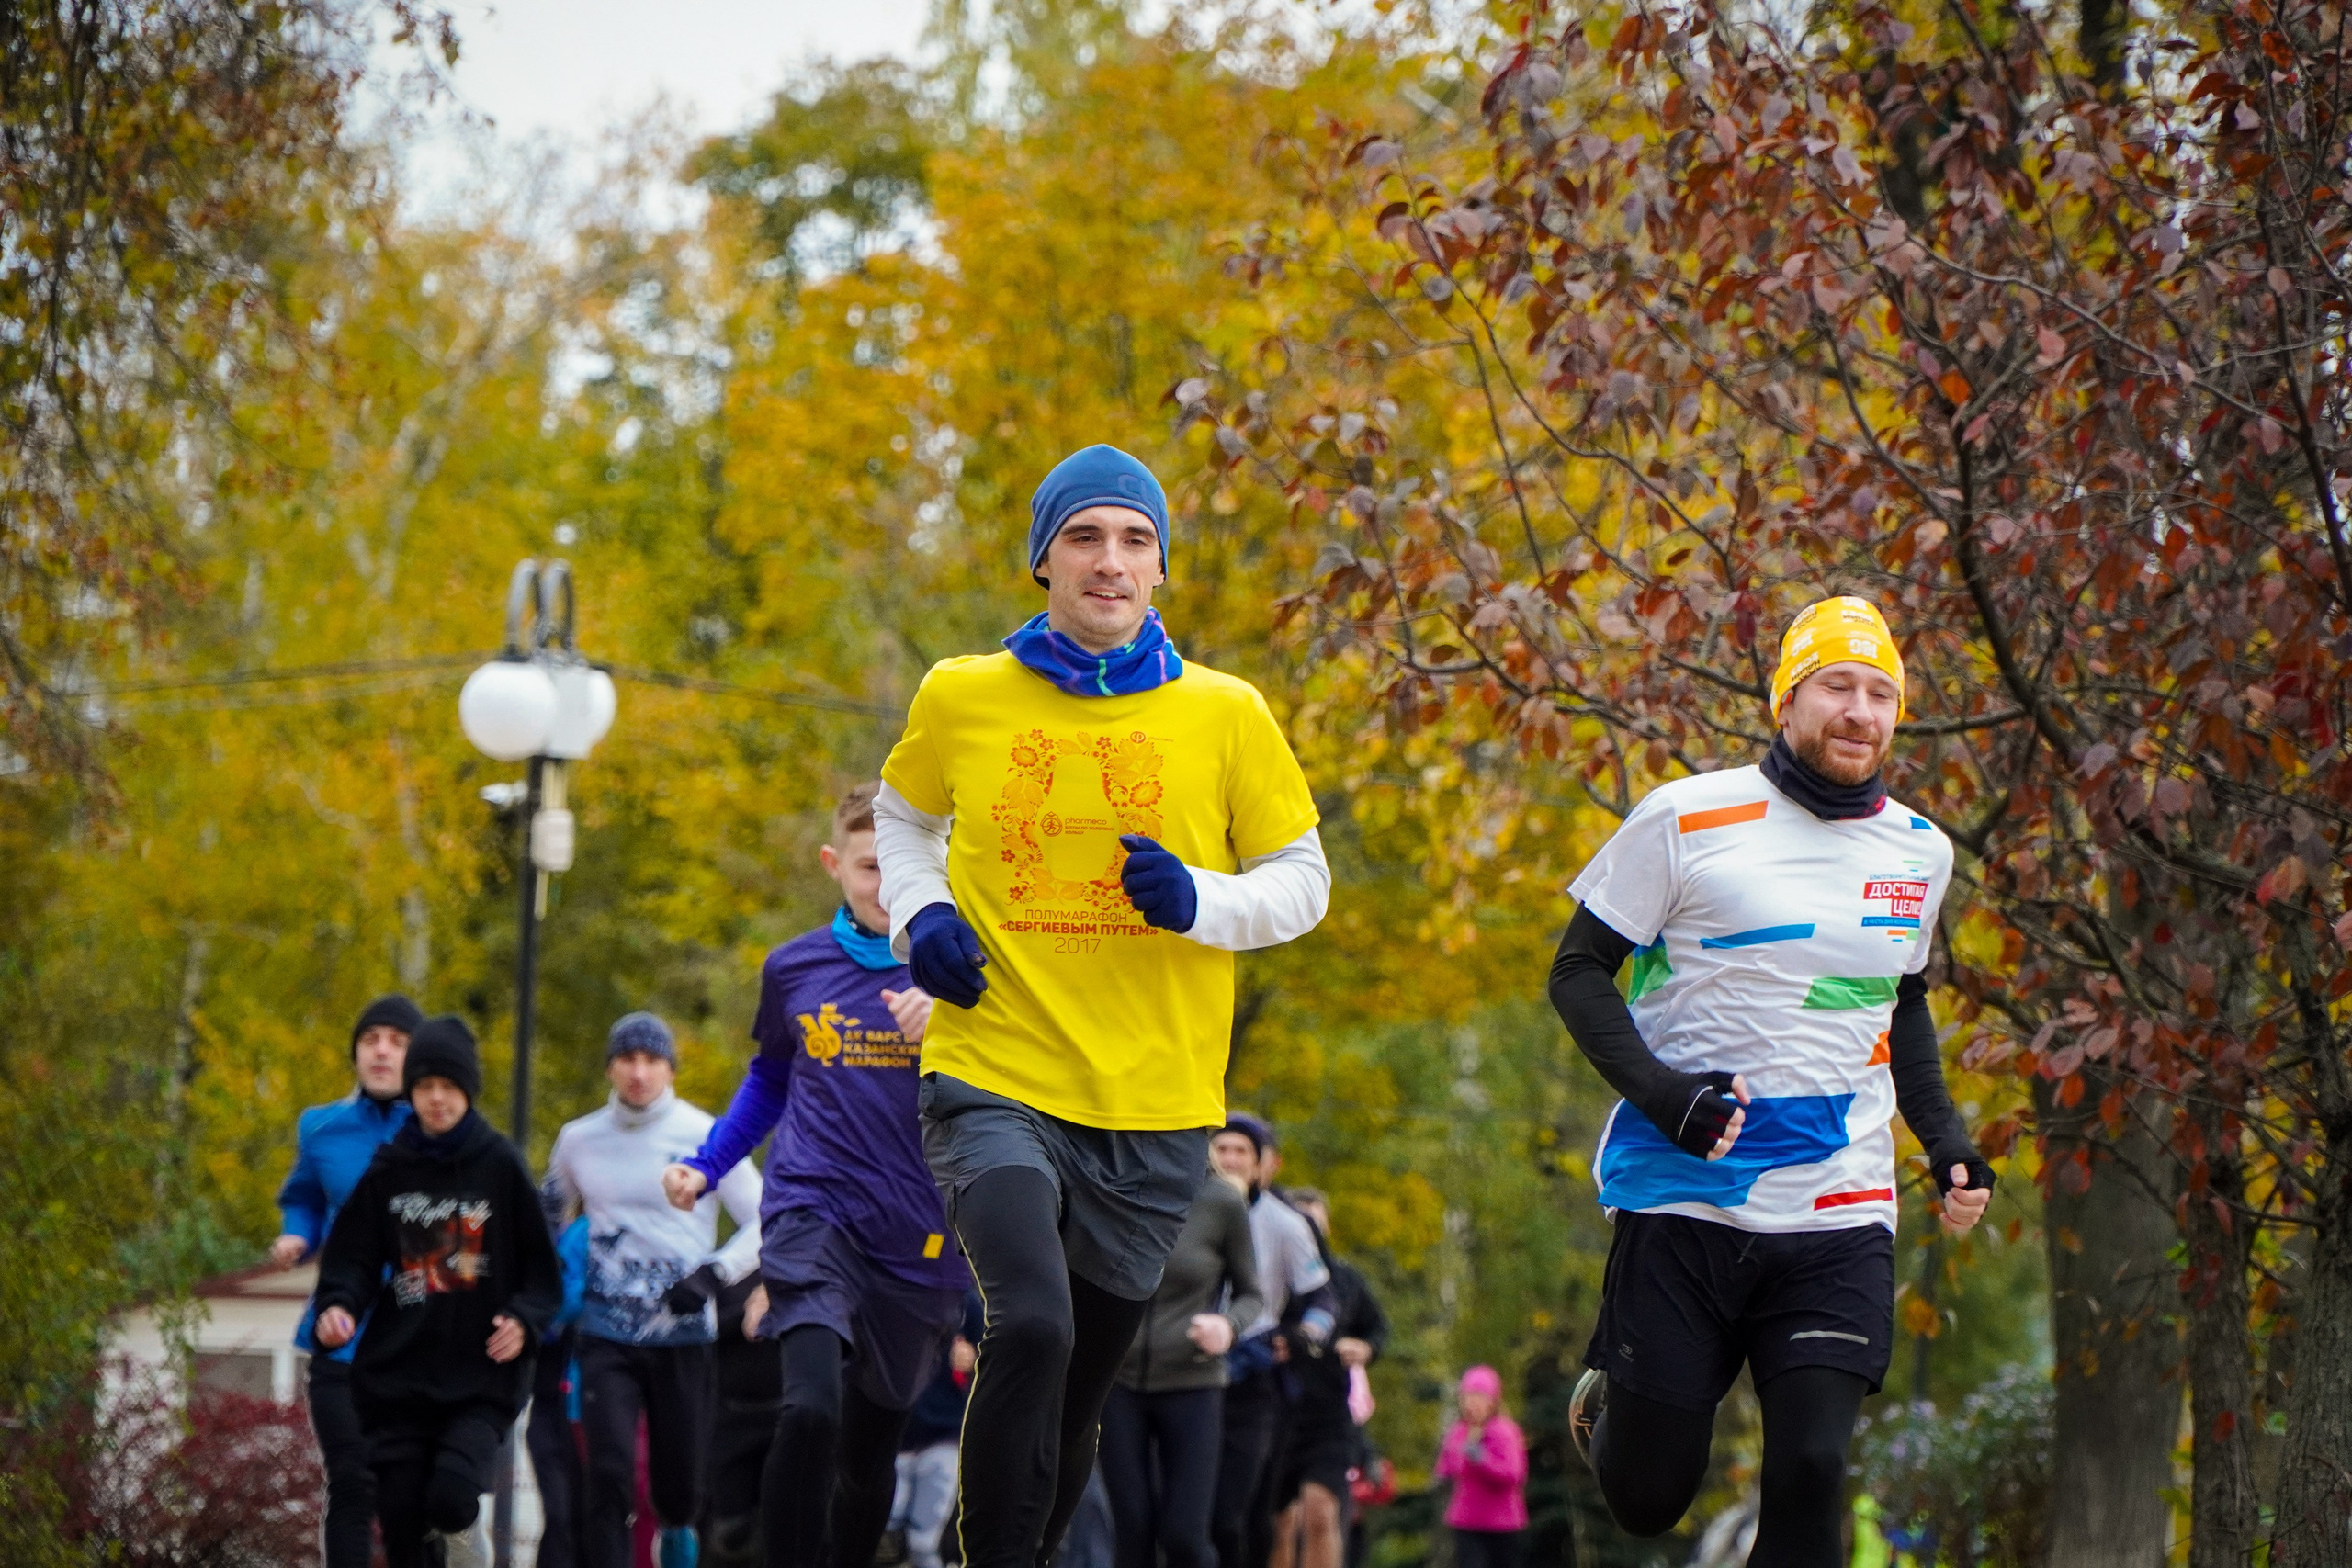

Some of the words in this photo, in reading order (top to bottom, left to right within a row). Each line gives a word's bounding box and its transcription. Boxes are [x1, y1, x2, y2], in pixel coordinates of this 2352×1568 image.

[1064, 817, 1108, 826] pharmeco
[1869, 883, 1925, 898] ДОСТИГАЯ
[1025, 909, 1127, 923] ПОЛУМАРАФОН
[1054, 937, 1101, 954] 2017
